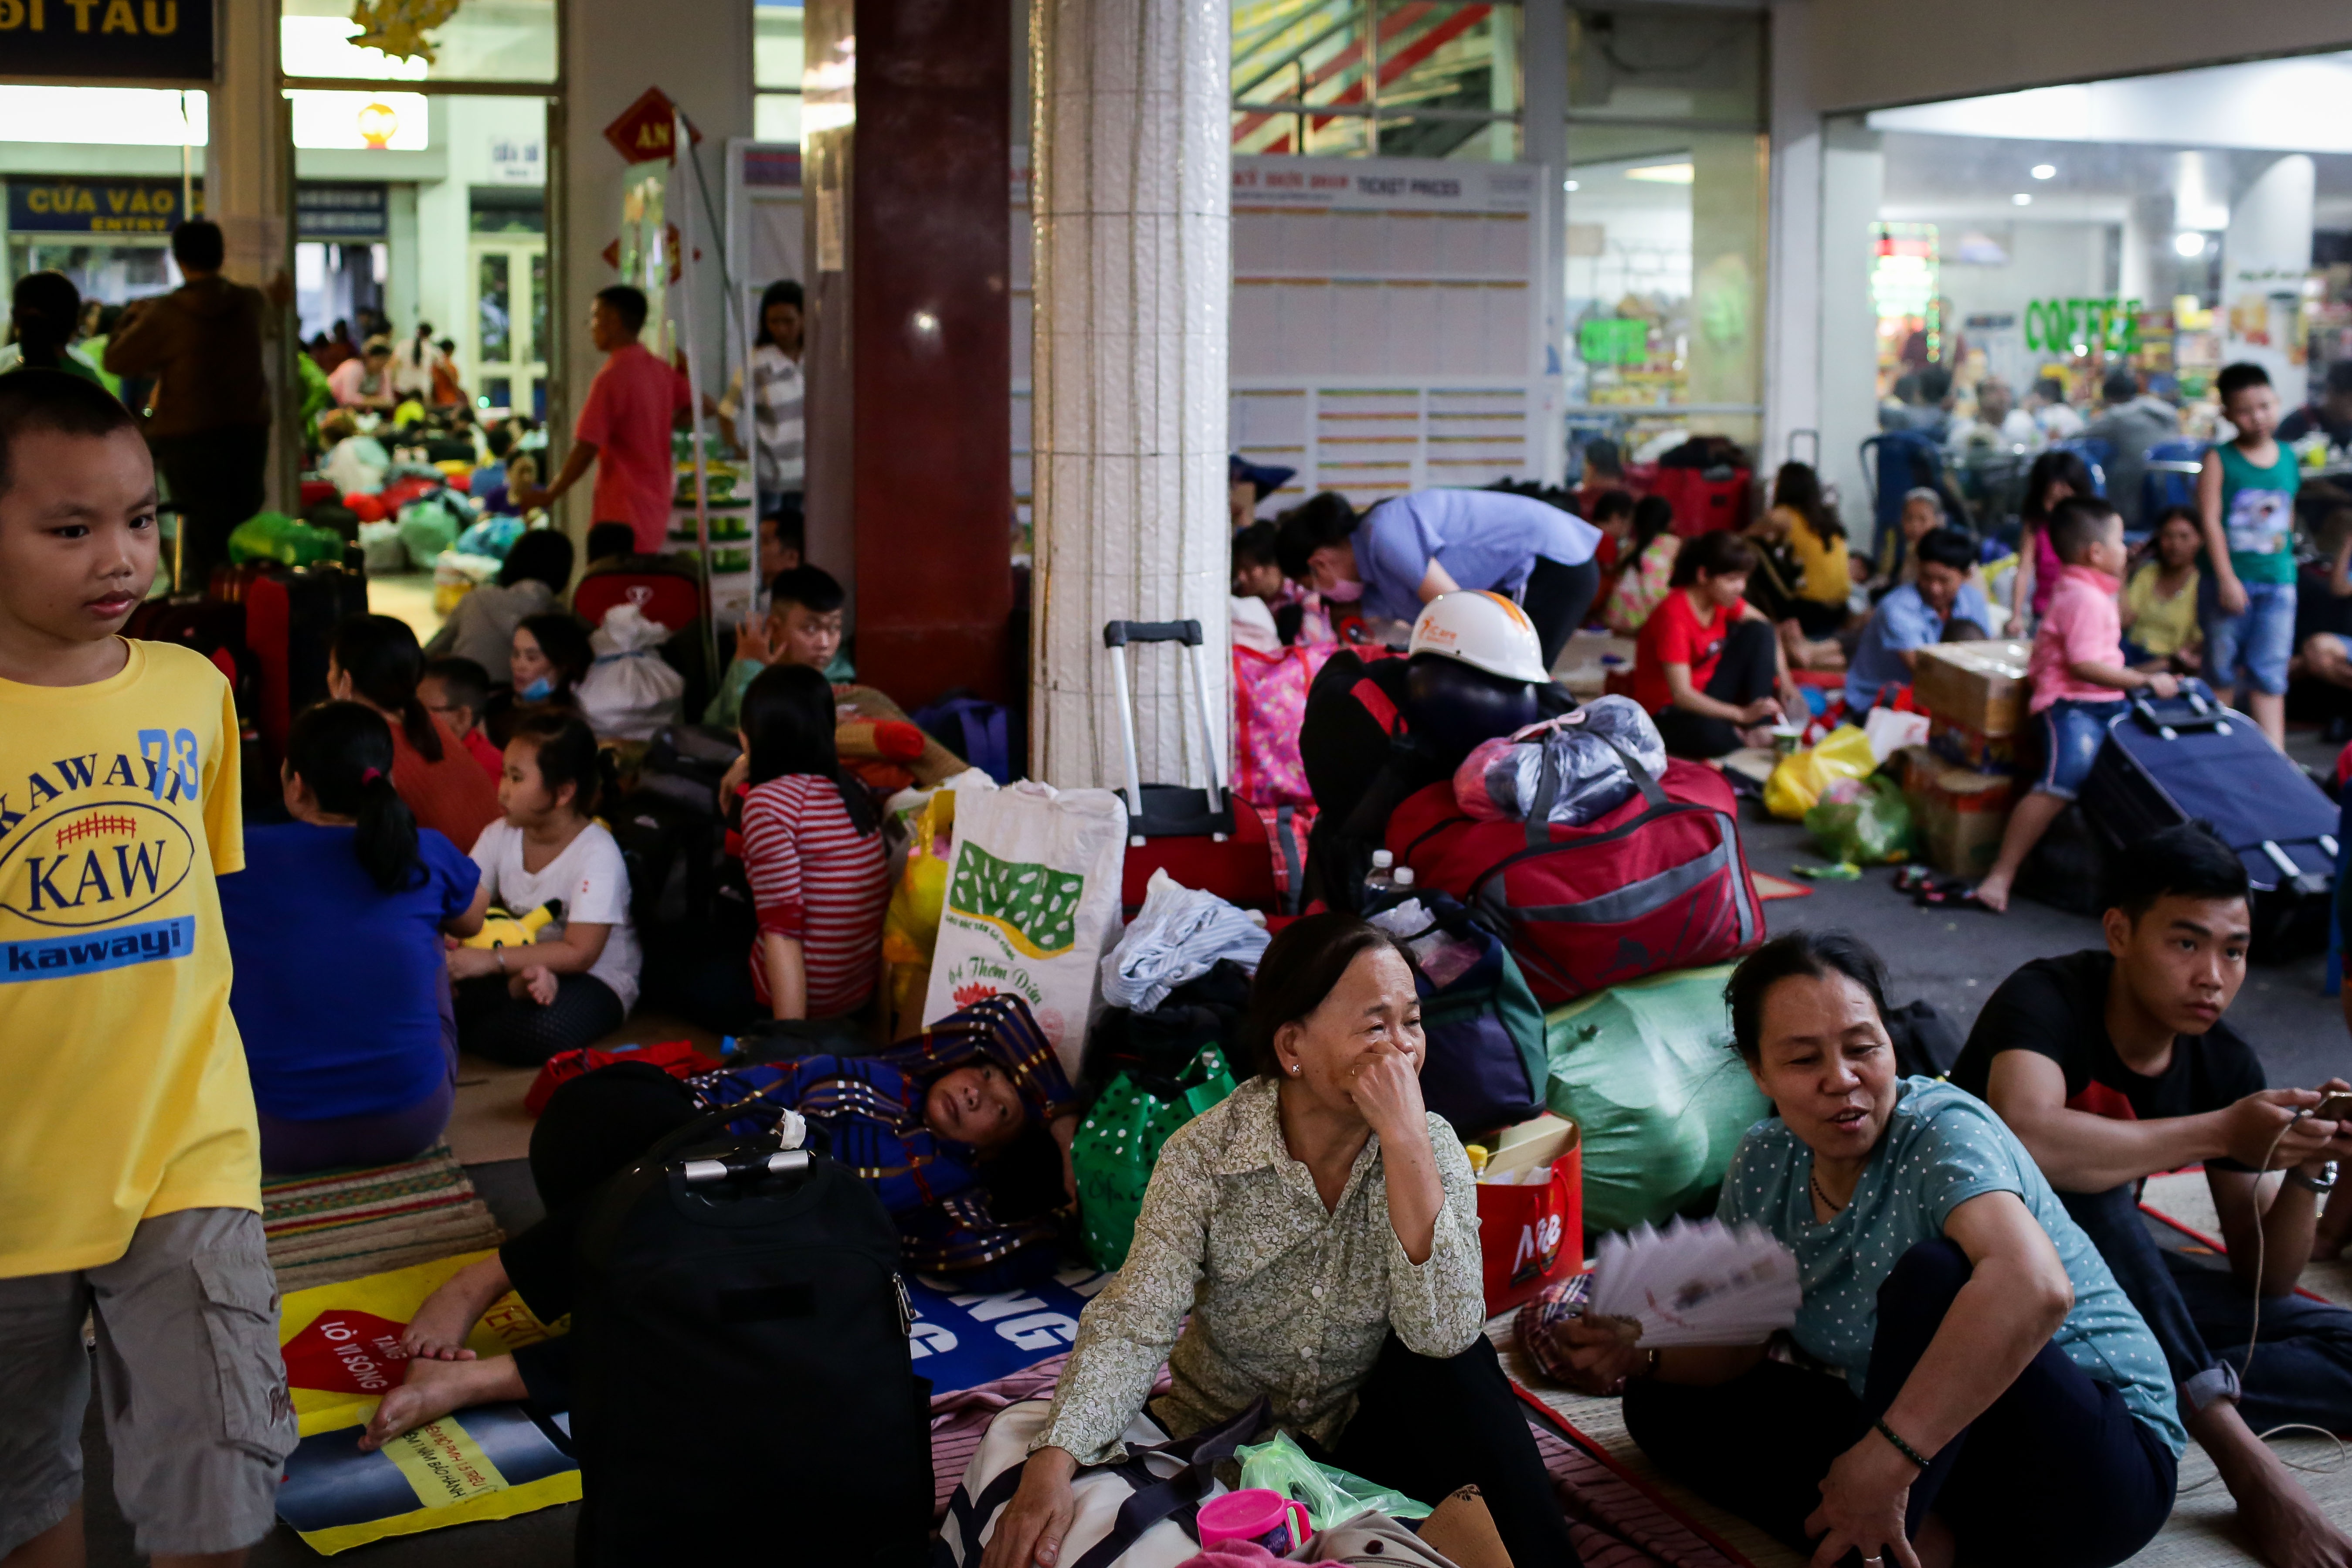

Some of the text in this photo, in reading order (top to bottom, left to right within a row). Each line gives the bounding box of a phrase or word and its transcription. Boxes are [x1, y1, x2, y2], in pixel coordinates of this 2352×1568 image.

[90, 217, 168, 231] ENTRY
[137, 728, 199, 801] 73
[25, 839, 166, 913] KAW
[8, 921, 181, 972] kawayi
[342, 1355, 388, 1389] SÓNG
